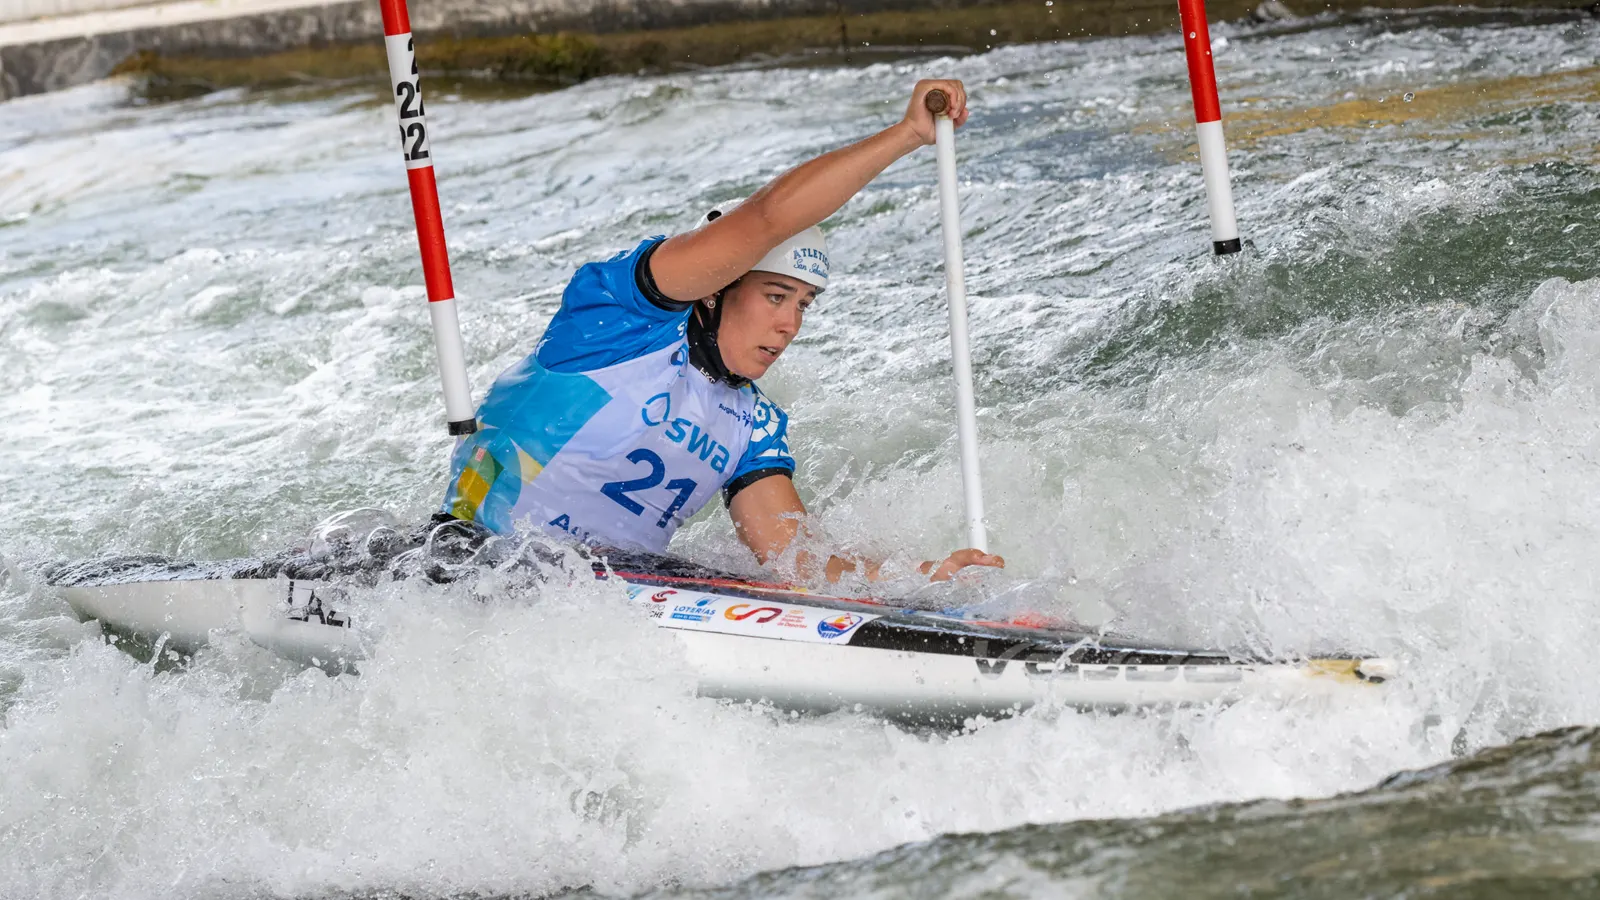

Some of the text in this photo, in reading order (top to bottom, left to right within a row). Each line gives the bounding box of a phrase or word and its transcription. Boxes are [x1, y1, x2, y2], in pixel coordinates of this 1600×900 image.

[793, 258, 807, 271] San
[664, 417, 730, 474] swa
[600, 448, 698, 529] 21
